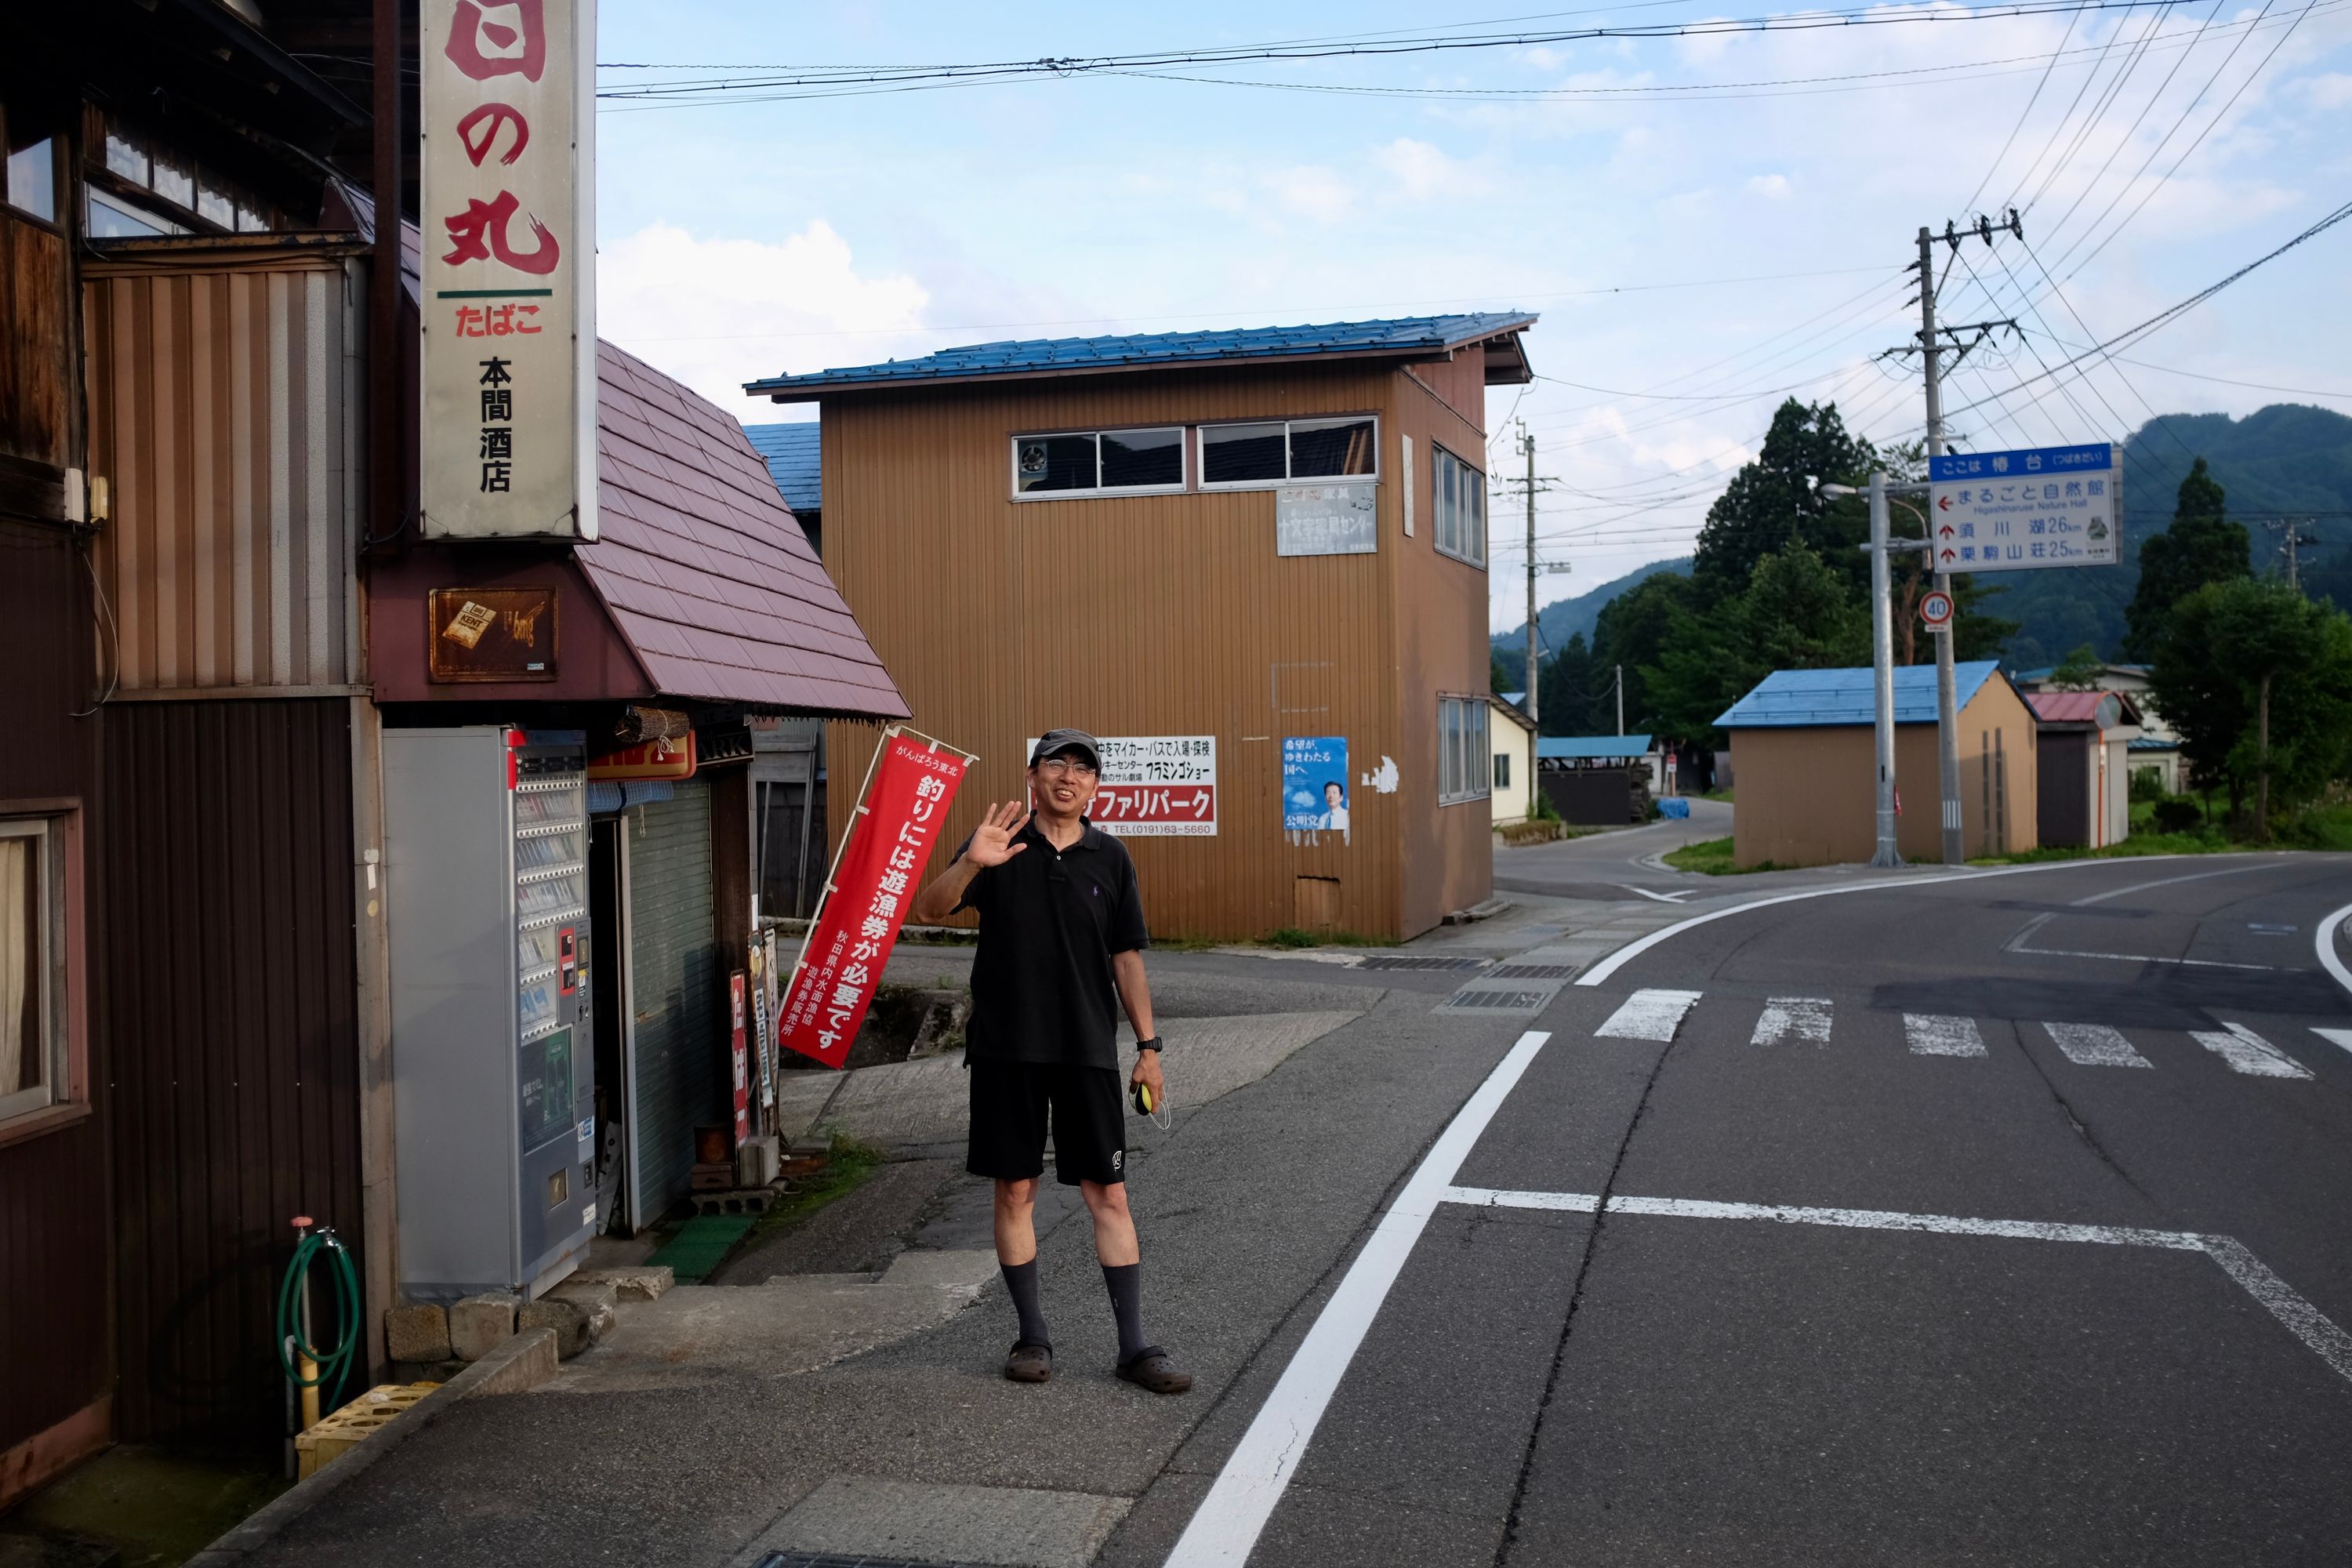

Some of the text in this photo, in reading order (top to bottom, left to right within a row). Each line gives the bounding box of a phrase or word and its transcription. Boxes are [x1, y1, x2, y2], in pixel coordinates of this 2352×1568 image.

[456, 304, 543, 338] たばこ
[479, 357, 513, 495] 本間酒店
[1943, 459, 1982, 475] ここは
[1958, 479, 2105, 505] まるごと自然館
[1974, 499, 2088, 516] Higashinaruse Nature Hall
[1958, 517, 2082, 539] 須川湖 26km
[1960, 540, 2083, 562] 栗駒山荘 25km
[1928, 601, 1946, 615] 40
[460, 614, 483, 627] KENT
[1285, 739, 1318, 750] 希望が、
[896, 745, 959, 777] がんばろう東北
[1285, 752, 1331, 763] ゆきわたる
[1145, 760, 1210, 781] フラミンゴショー
[1114, 825, 1210, 834] TEL(0191)63-5660
[1286, 815, 1319, 826] 公明党
[817, 775, 946, 1050] 釣りには遊漁券が必要です
[801, 930, 848, 1026] 秋田県内水面漁協
[781, 964, 817, 1036] 遊漁券販売所
